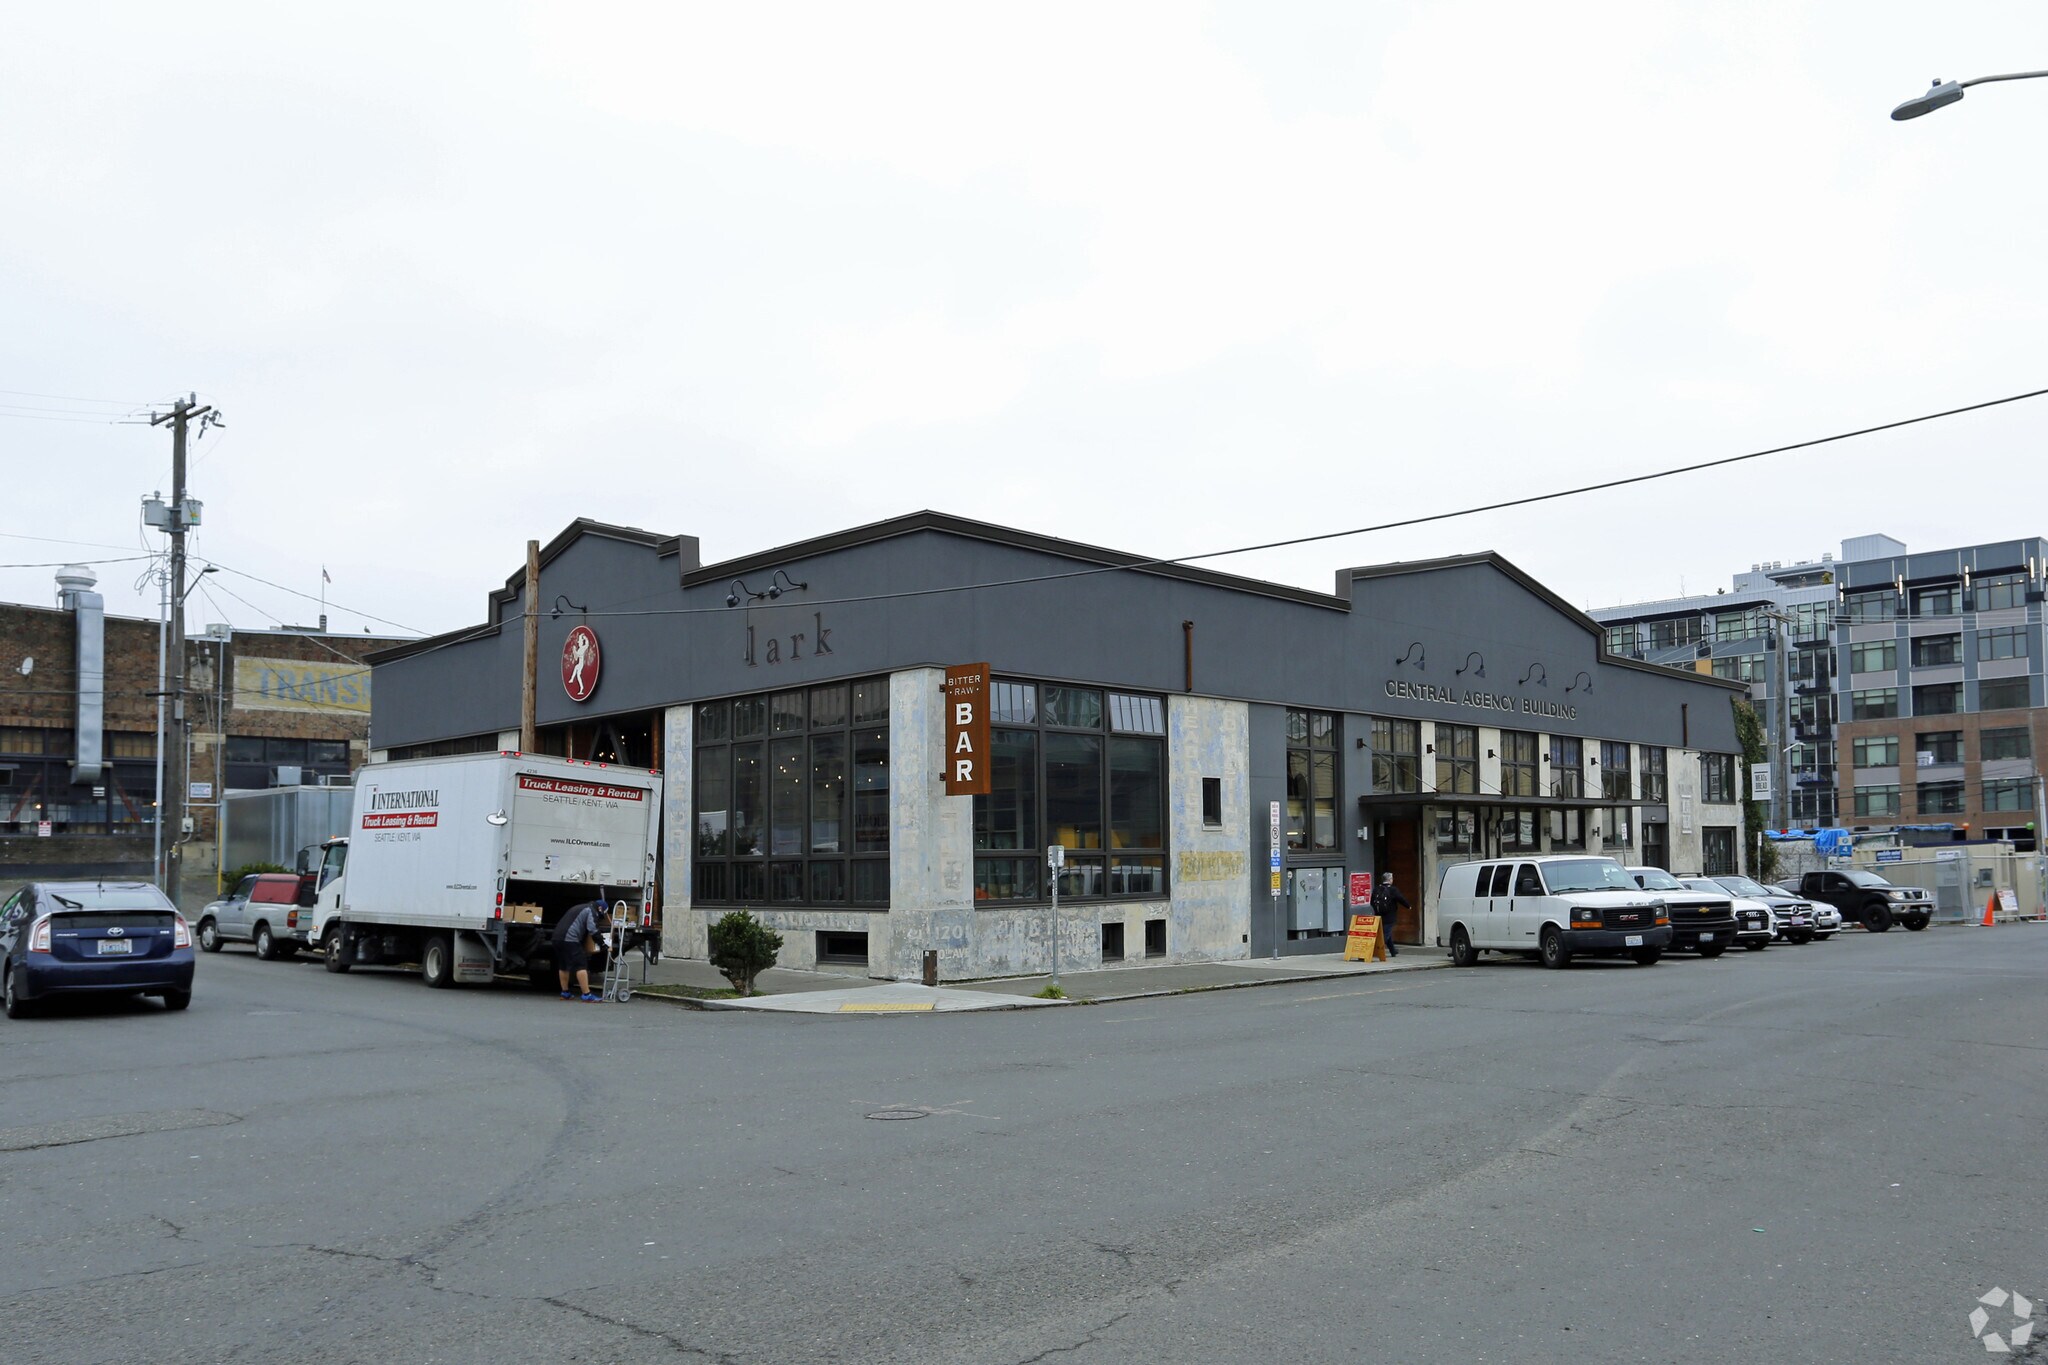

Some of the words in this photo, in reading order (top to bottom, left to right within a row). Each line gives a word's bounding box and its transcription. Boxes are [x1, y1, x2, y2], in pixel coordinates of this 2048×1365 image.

[747, 611, 833, 668] lark
[948, 674, 981, 686] BITTER
[1384, 679, 1457, 705] CENTRAL
[1461, 690, 1517, 712] AGENCY
[1521, 698, 1577, 721] BUILDING
[954, 702, 973, 782] BAR
[523, 779, 553, 790] Truck
[555, 782, 595, 796] Leasing
[607, 788, 640, 799] Rental
[377, 790, 440, 810] INTERNATIONAL
[606, 801, 619, 809] WA
[363, 816, 381, 827] Truck
[381, 815, 407, 828] Leasing
[407, 814, 413, 826] &
[413, 814, 437, 825] Rental
[550, 838, 611, 848] www.ILCOrental.com
